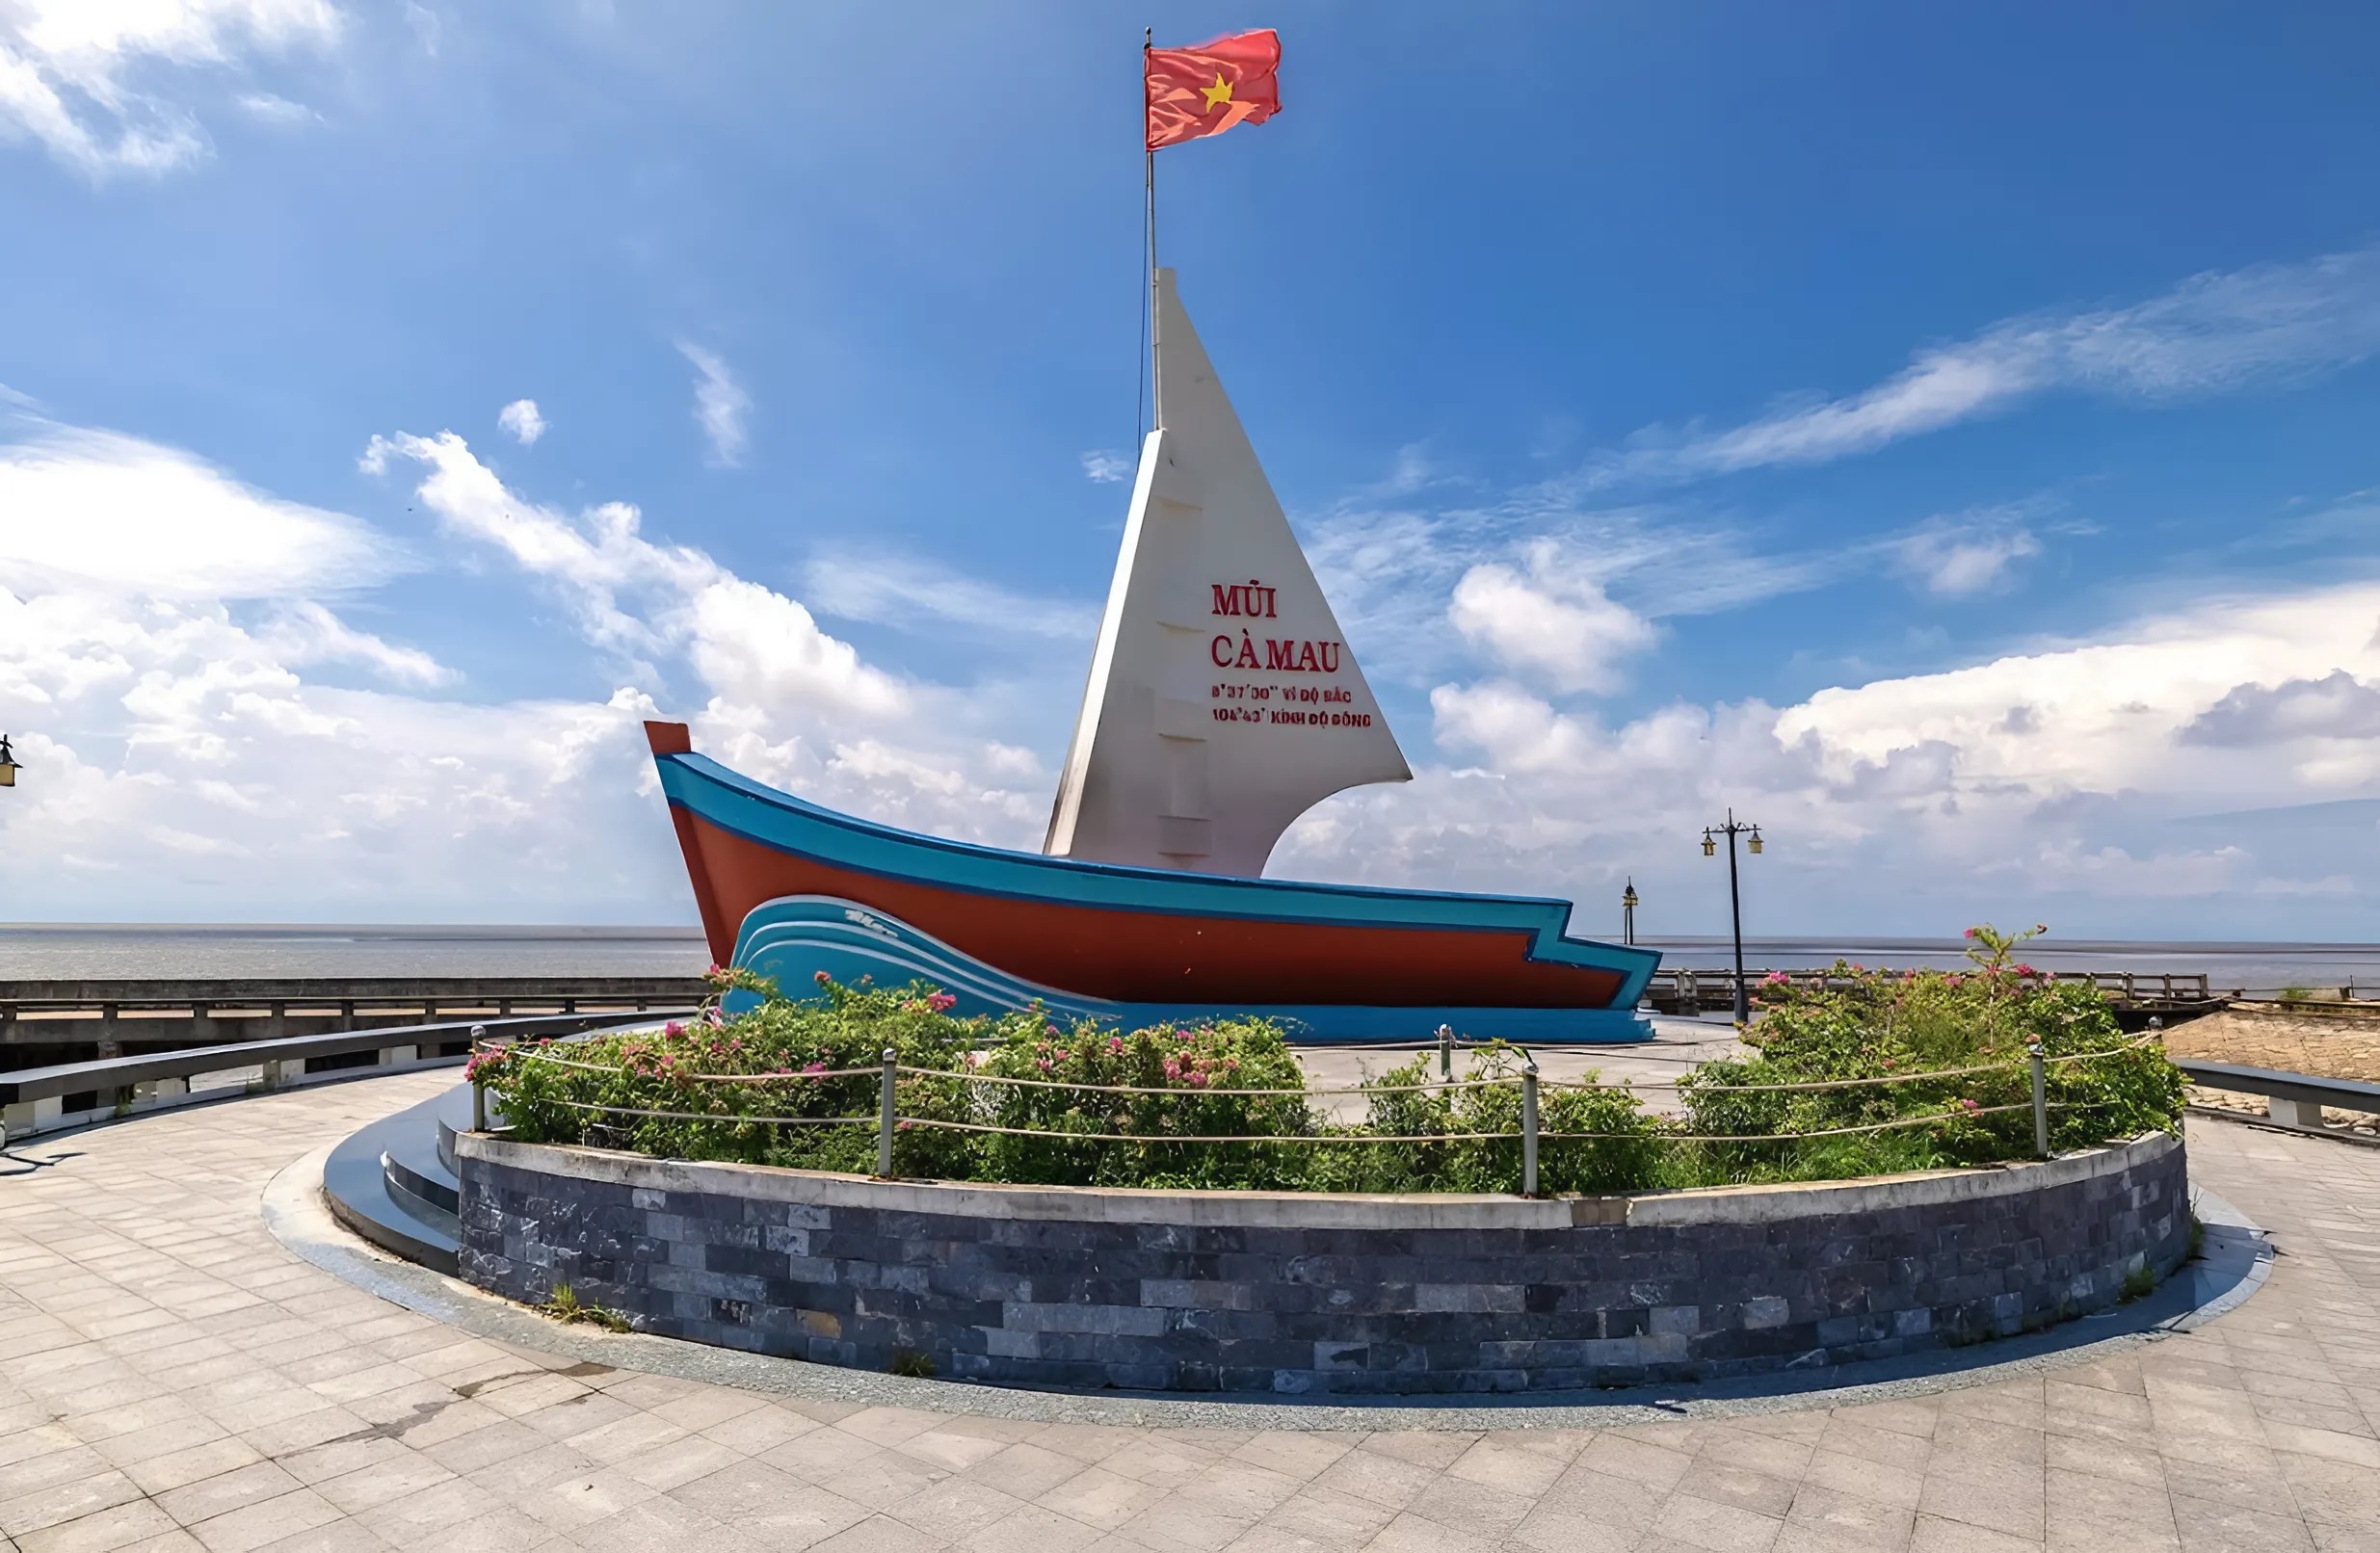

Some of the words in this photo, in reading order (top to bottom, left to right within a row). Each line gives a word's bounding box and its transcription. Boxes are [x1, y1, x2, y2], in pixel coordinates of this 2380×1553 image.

[1211, 579, 1277, 618] MŨI
[1211, 628, 1261, 669] CÀ
[1265, 639, 1340, 672] MAU
